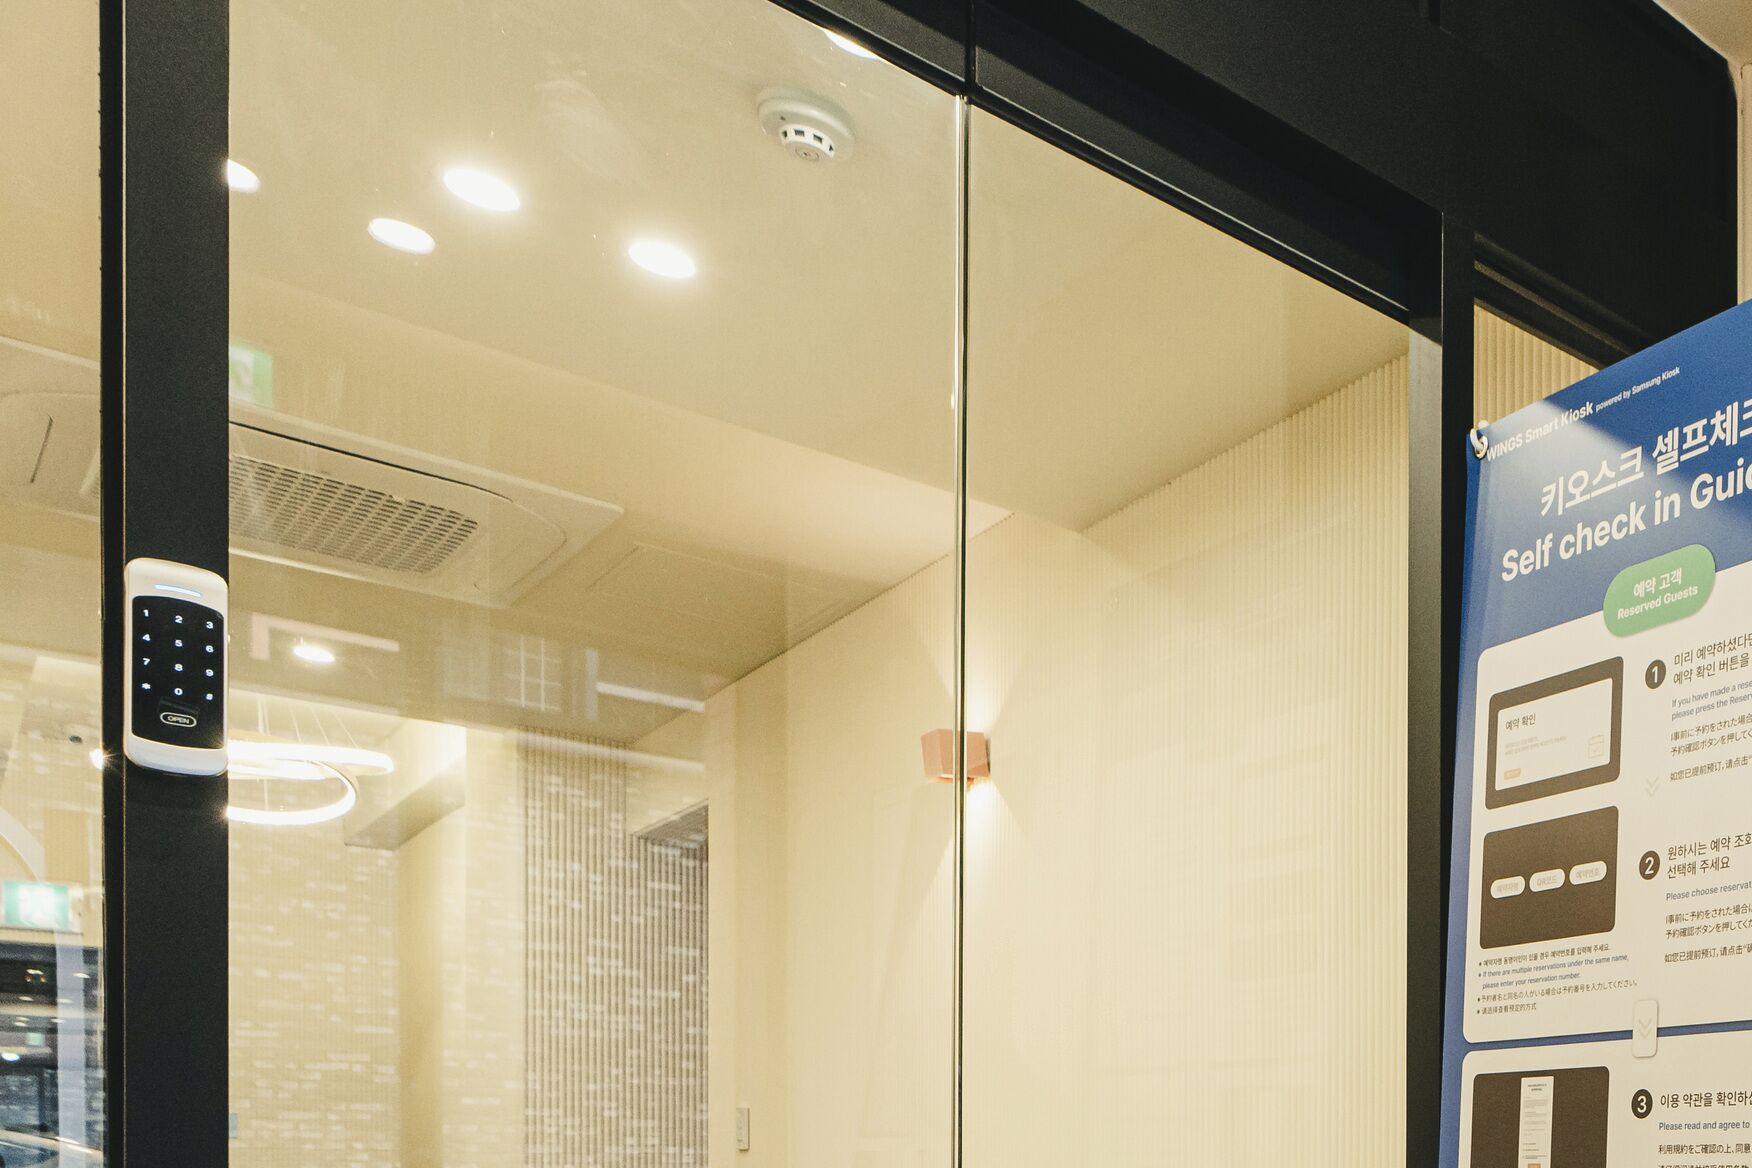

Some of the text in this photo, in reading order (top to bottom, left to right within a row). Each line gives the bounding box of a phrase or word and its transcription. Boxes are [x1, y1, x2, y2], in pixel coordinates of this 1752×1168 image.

[1487, 366, 1680, 462] WINGS Smart Kiosk powered by Samsung Kiosk
[1540, 445, 1644, 517] 키오스크
[1501, 537, 1553, 582] Self
[1558, 505, 1647, 561] check
[1654, 492, 1681, 525] in
[1633, 568, 1683, 599] 예약 고객
[1617, 585, 1699, 621] Reserved Guests
[143, 658, 150, 666] 7
[1674, 650, 1694, 667] 미리
[1673, 669, 1693, 686] 예약
[1695, 662, 1715, 679] 확인
[1718, 652, 1750, 672] 버튼을
[175, 688, 182, 696] 0
[168, 715, 189, 724] OPEN
[1668, 841, 1707, 861] 원하시는
[1710, 836, 1731, 853] 예약
[1645, 857, 1654, 874] 2
[1667, 856, 1731, 879] 선택해 주세요
[1637, 1096, 1647, 1113] 3
[1660, 1093, 1680, 1109] 이용
[1682, 1092, 1713, 1108] 약관을
[1658, 1122, 1682, 1131] Please
[1684, 1121, 1701, 1130] read
[1702, 1121, 1717, 1129] and
[1718, 1121, 1740, 1131] agree
[1742, 1120, 1750, 1129] to
